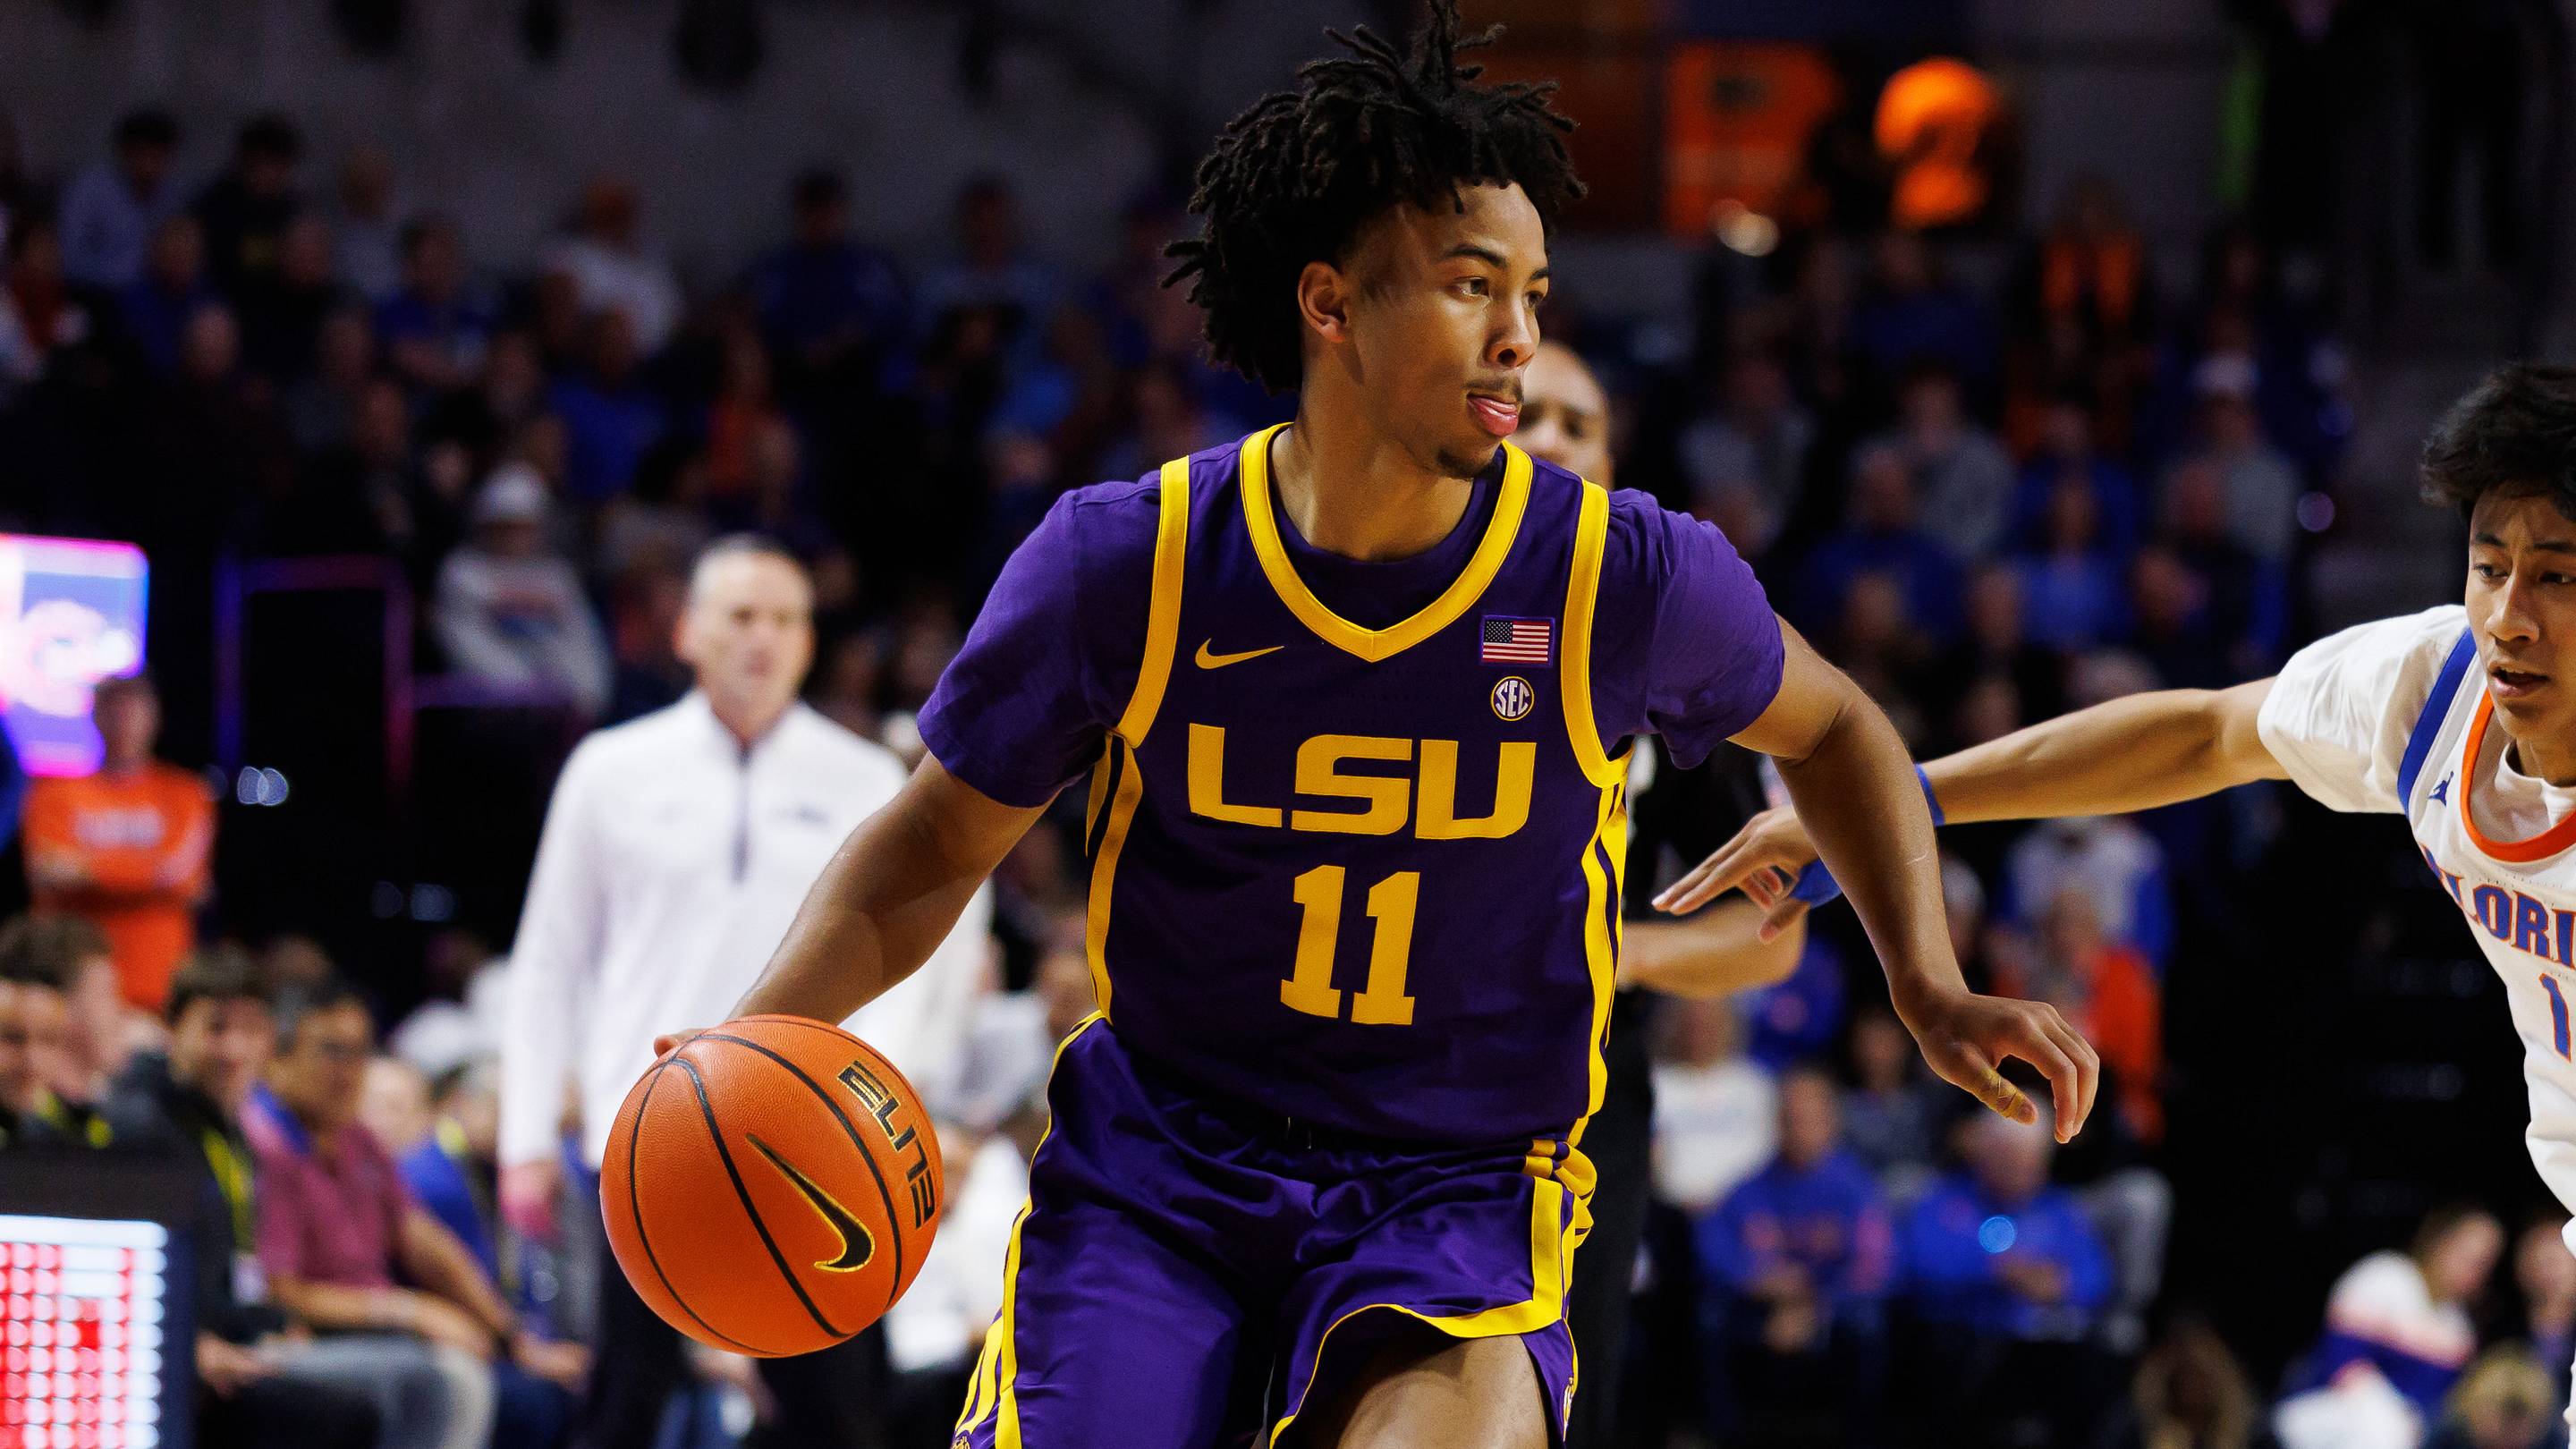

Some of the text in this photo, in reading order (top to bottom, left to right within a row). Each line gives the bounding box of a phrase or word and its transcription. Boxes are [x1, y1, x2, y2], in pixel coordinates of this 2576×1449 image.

[1496, 680, 1530, 716] SEC
[1187, 723, 1538, 840] LSU
[1280, 864, 1420, 1026] 11
[837, 1060, 936, 1229] ELITE
